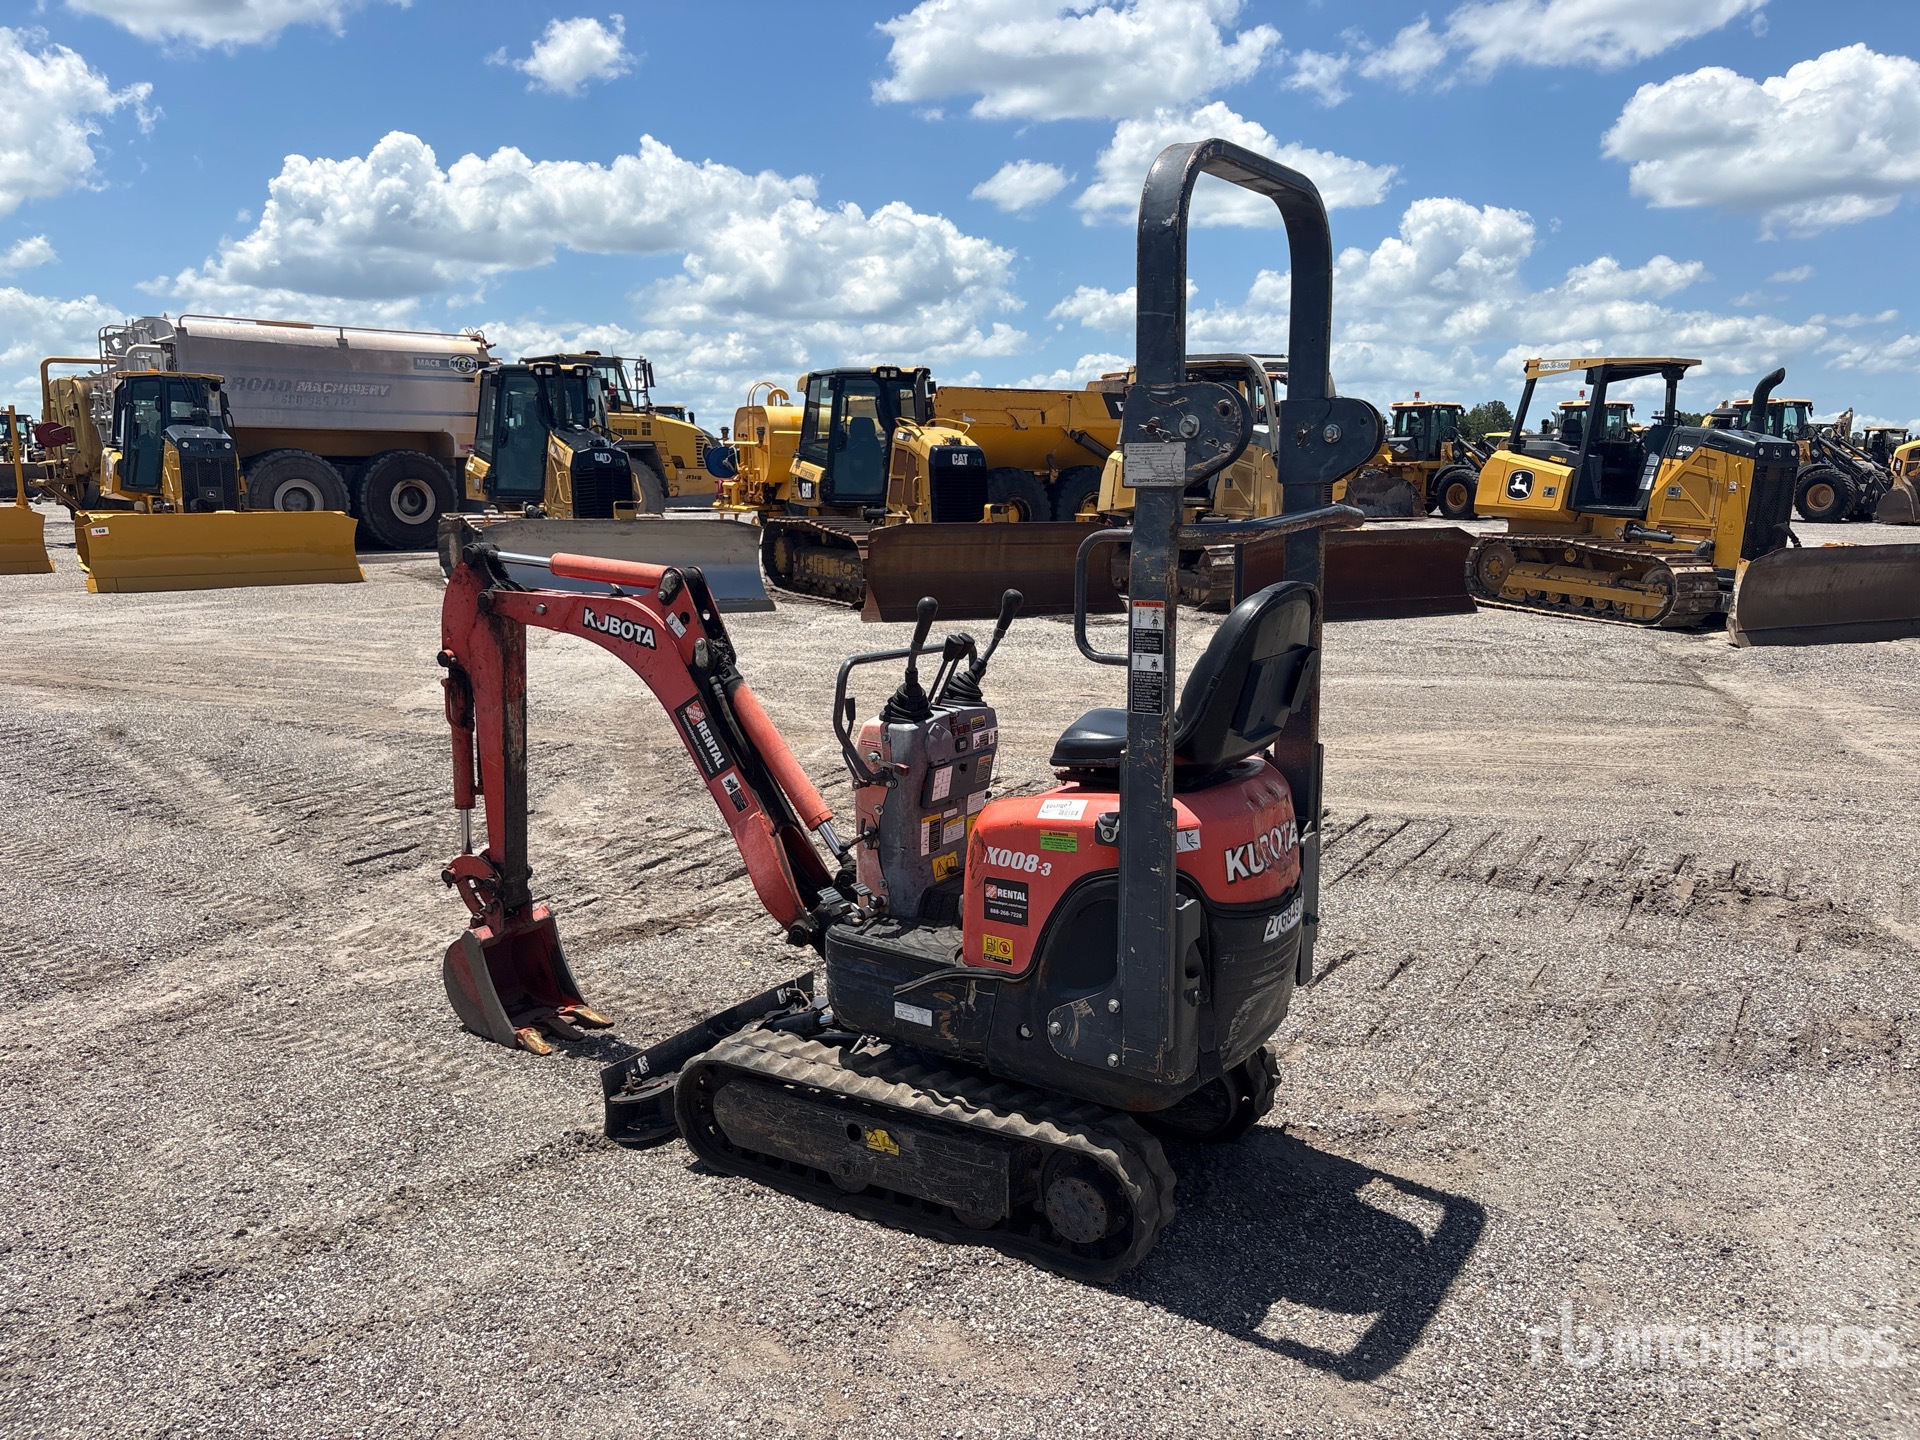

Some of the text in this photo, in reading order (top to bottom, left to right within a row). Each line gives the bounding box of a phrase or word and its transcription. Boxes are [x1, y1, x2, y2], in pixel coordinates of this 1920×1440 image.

[450, 360, 478, 369] MEGA
[230, 376, 391, 396] ROAD MACHINERY
[952, 453, 969, 466] CAT
[802, 482, 812, 498] CAT
[582, 607, 657, 650] KUBOTA
[681, 714, 715, 775] homedepot.com/rental
[697, 720, 725, 769] RENTAL
[997, 888, 1027, 902] RENTAL
